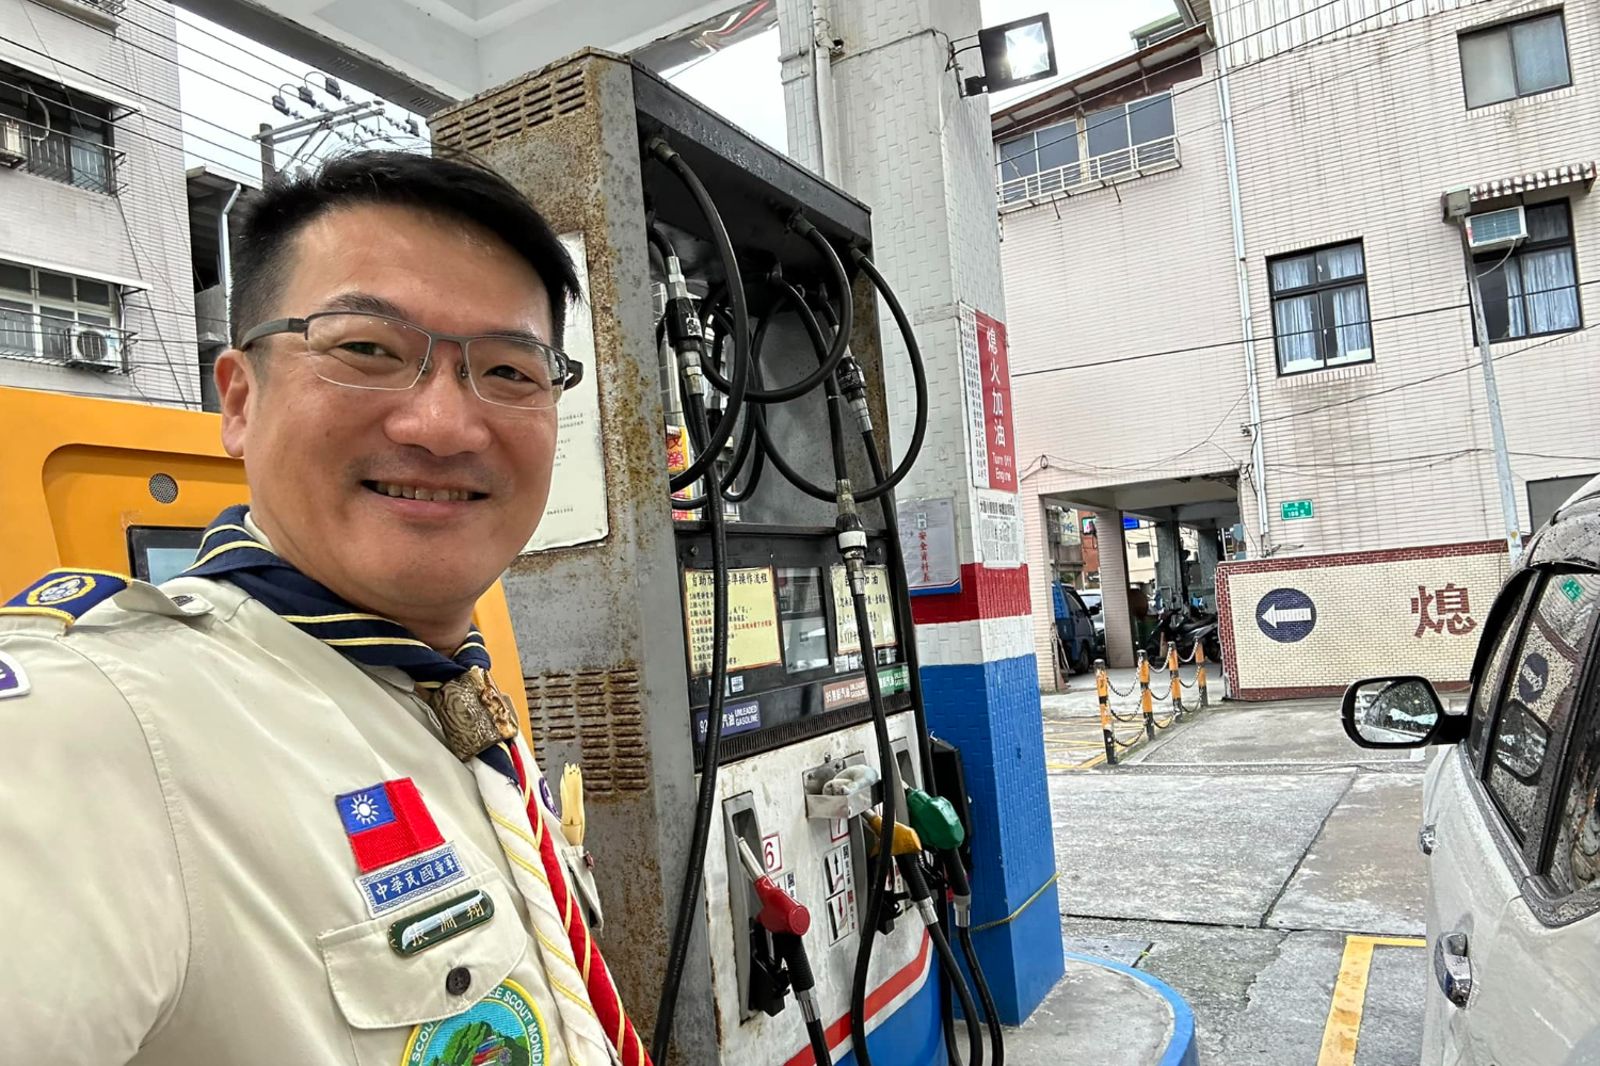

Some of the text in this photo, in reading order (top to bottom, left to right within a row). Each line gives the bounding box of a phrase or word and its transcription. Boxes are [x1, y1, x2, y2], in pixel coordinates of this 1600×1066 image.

[986, 327, 1006, 447] 熄火加油
[995, 467, 1011, 483] Engine
[1411, 583, 1478, 639] 熄
[734, 704, 758, 717] UNLEADED
[736, 713, 760, 727] GASOLINE
[764, 841, 775, 869] 6
[375, 854, 456, 901] 中華民國童軍
[503, 990, 533, 1021] SCOUT
[527, 1022, 543, 1066] MOND
